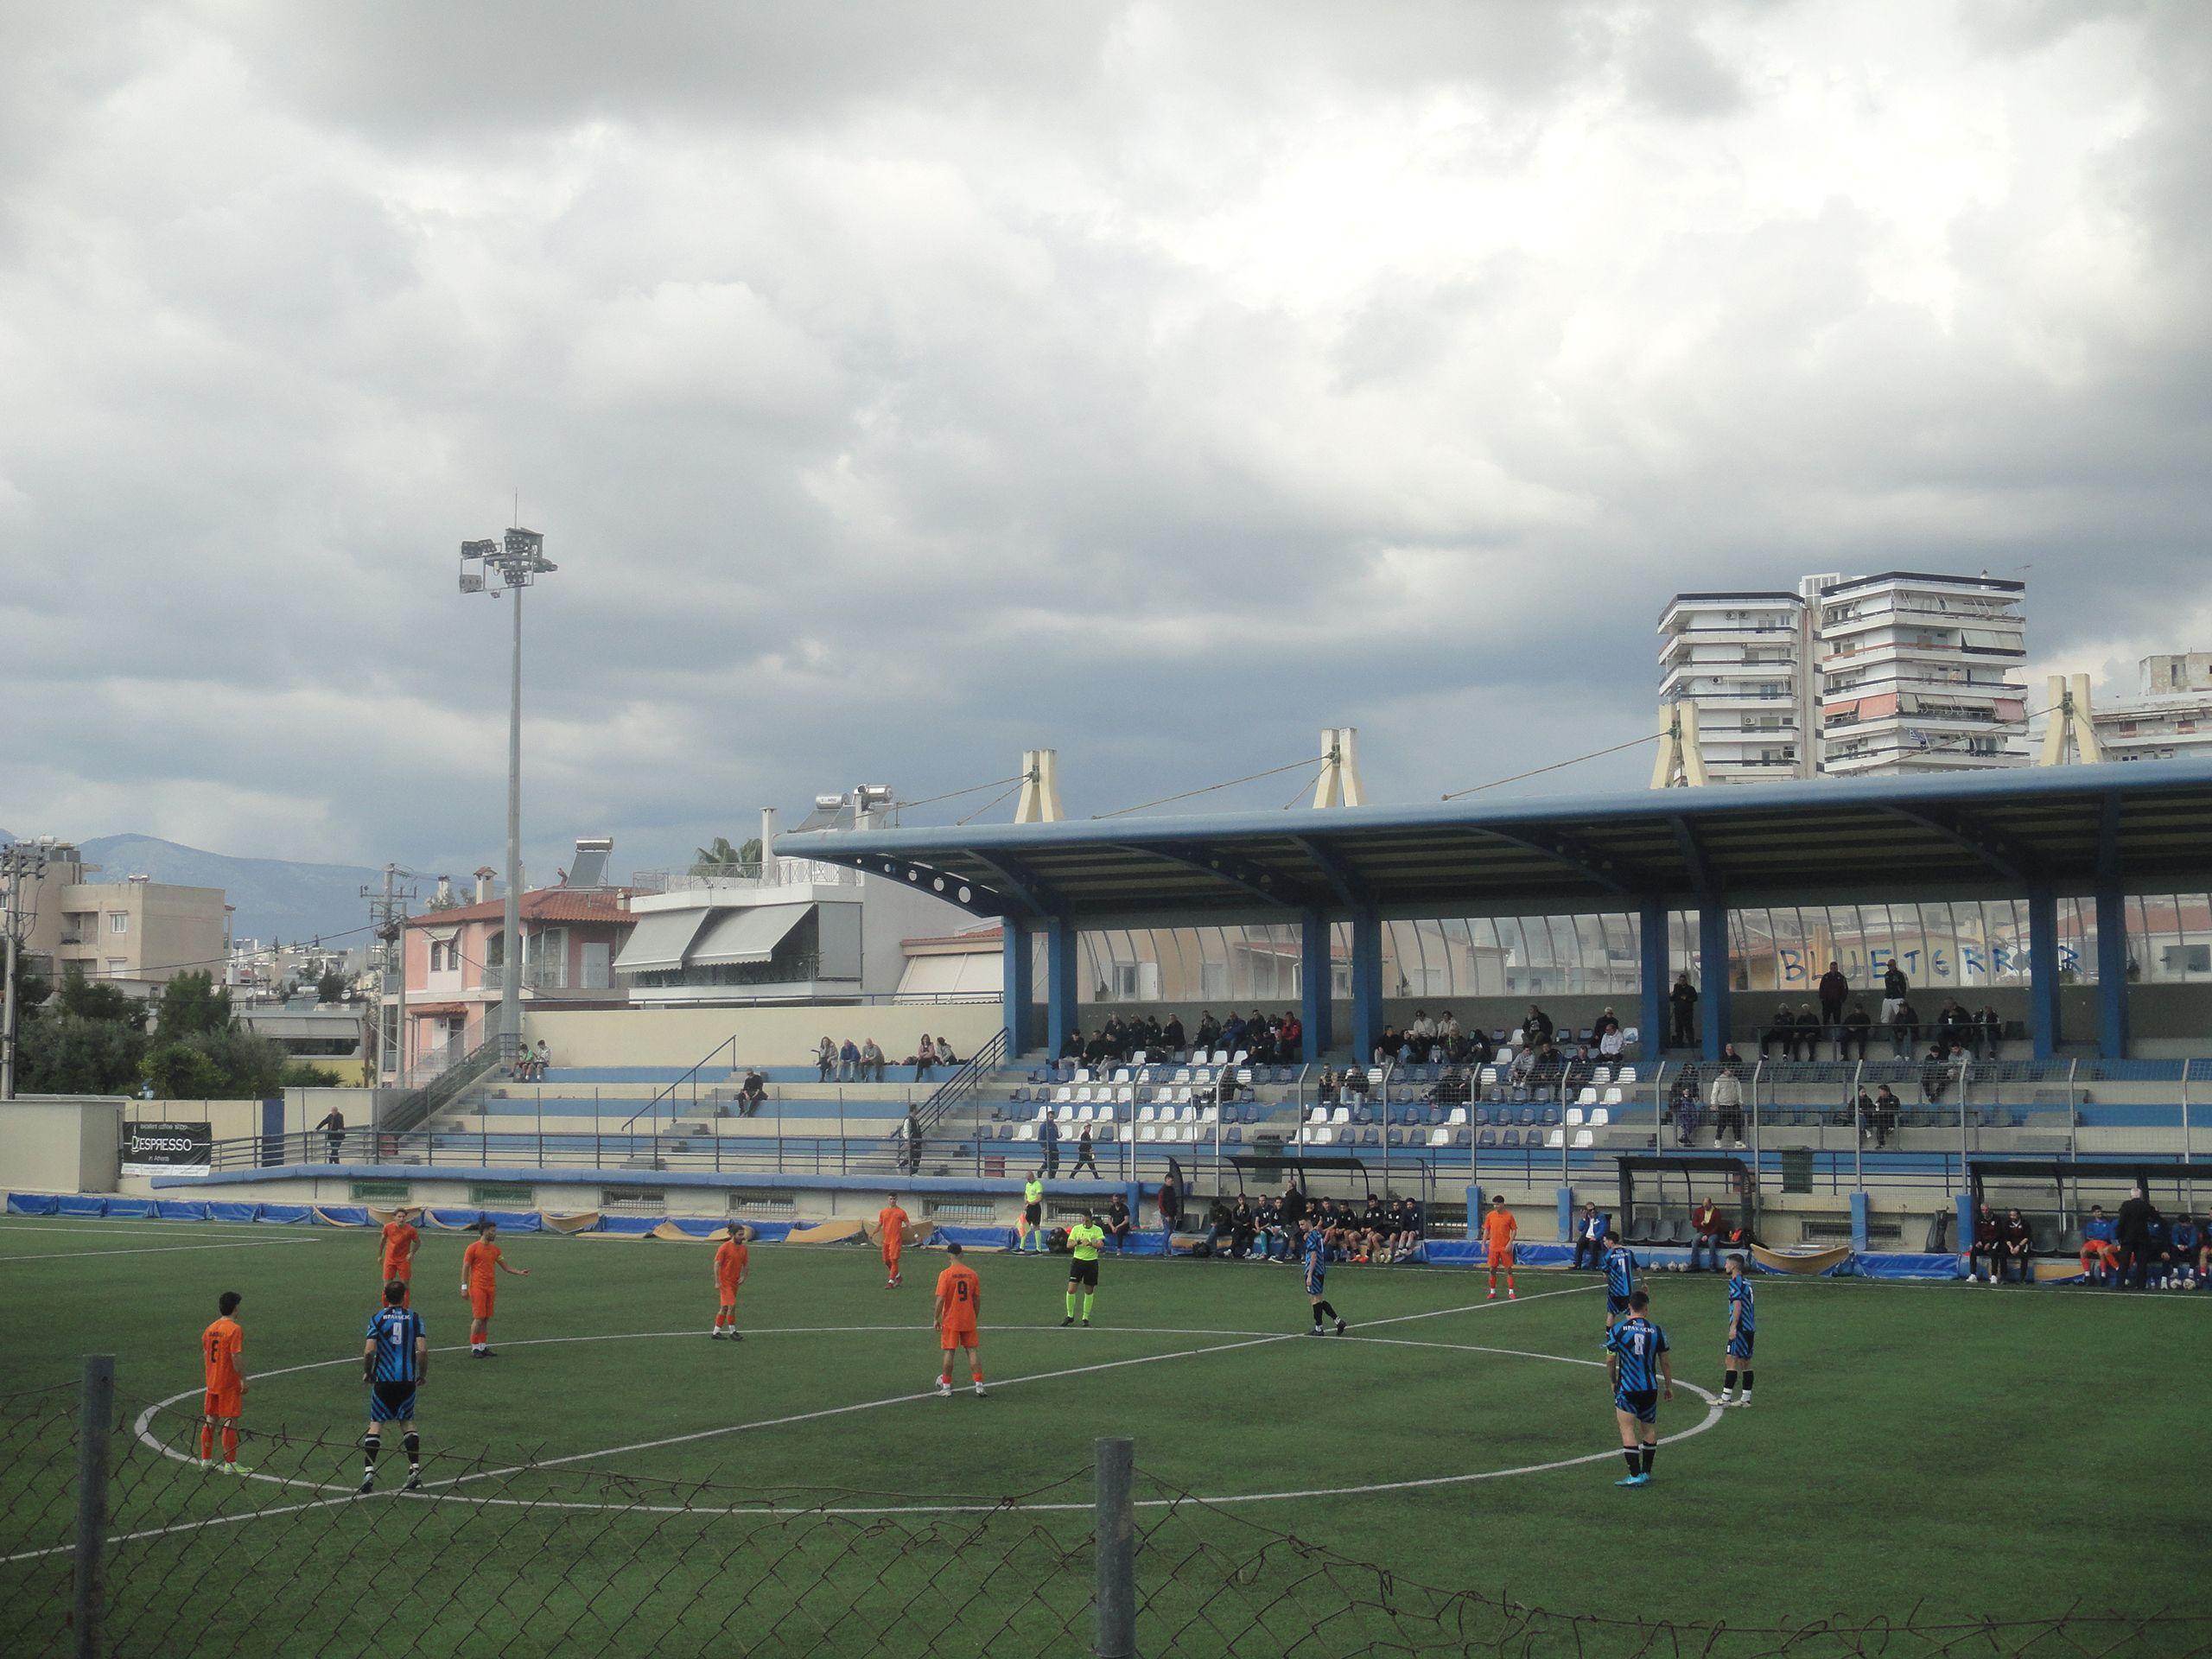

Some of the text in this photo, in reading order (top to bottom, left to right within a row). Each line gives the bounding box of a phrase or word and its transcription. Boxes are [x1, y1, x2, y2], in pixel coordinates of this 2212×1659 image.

[957, 1281, 968, 1302] 9
[392, 1322, 403, 1345] 9
[1634, 1333, 1645, 1356] 8
